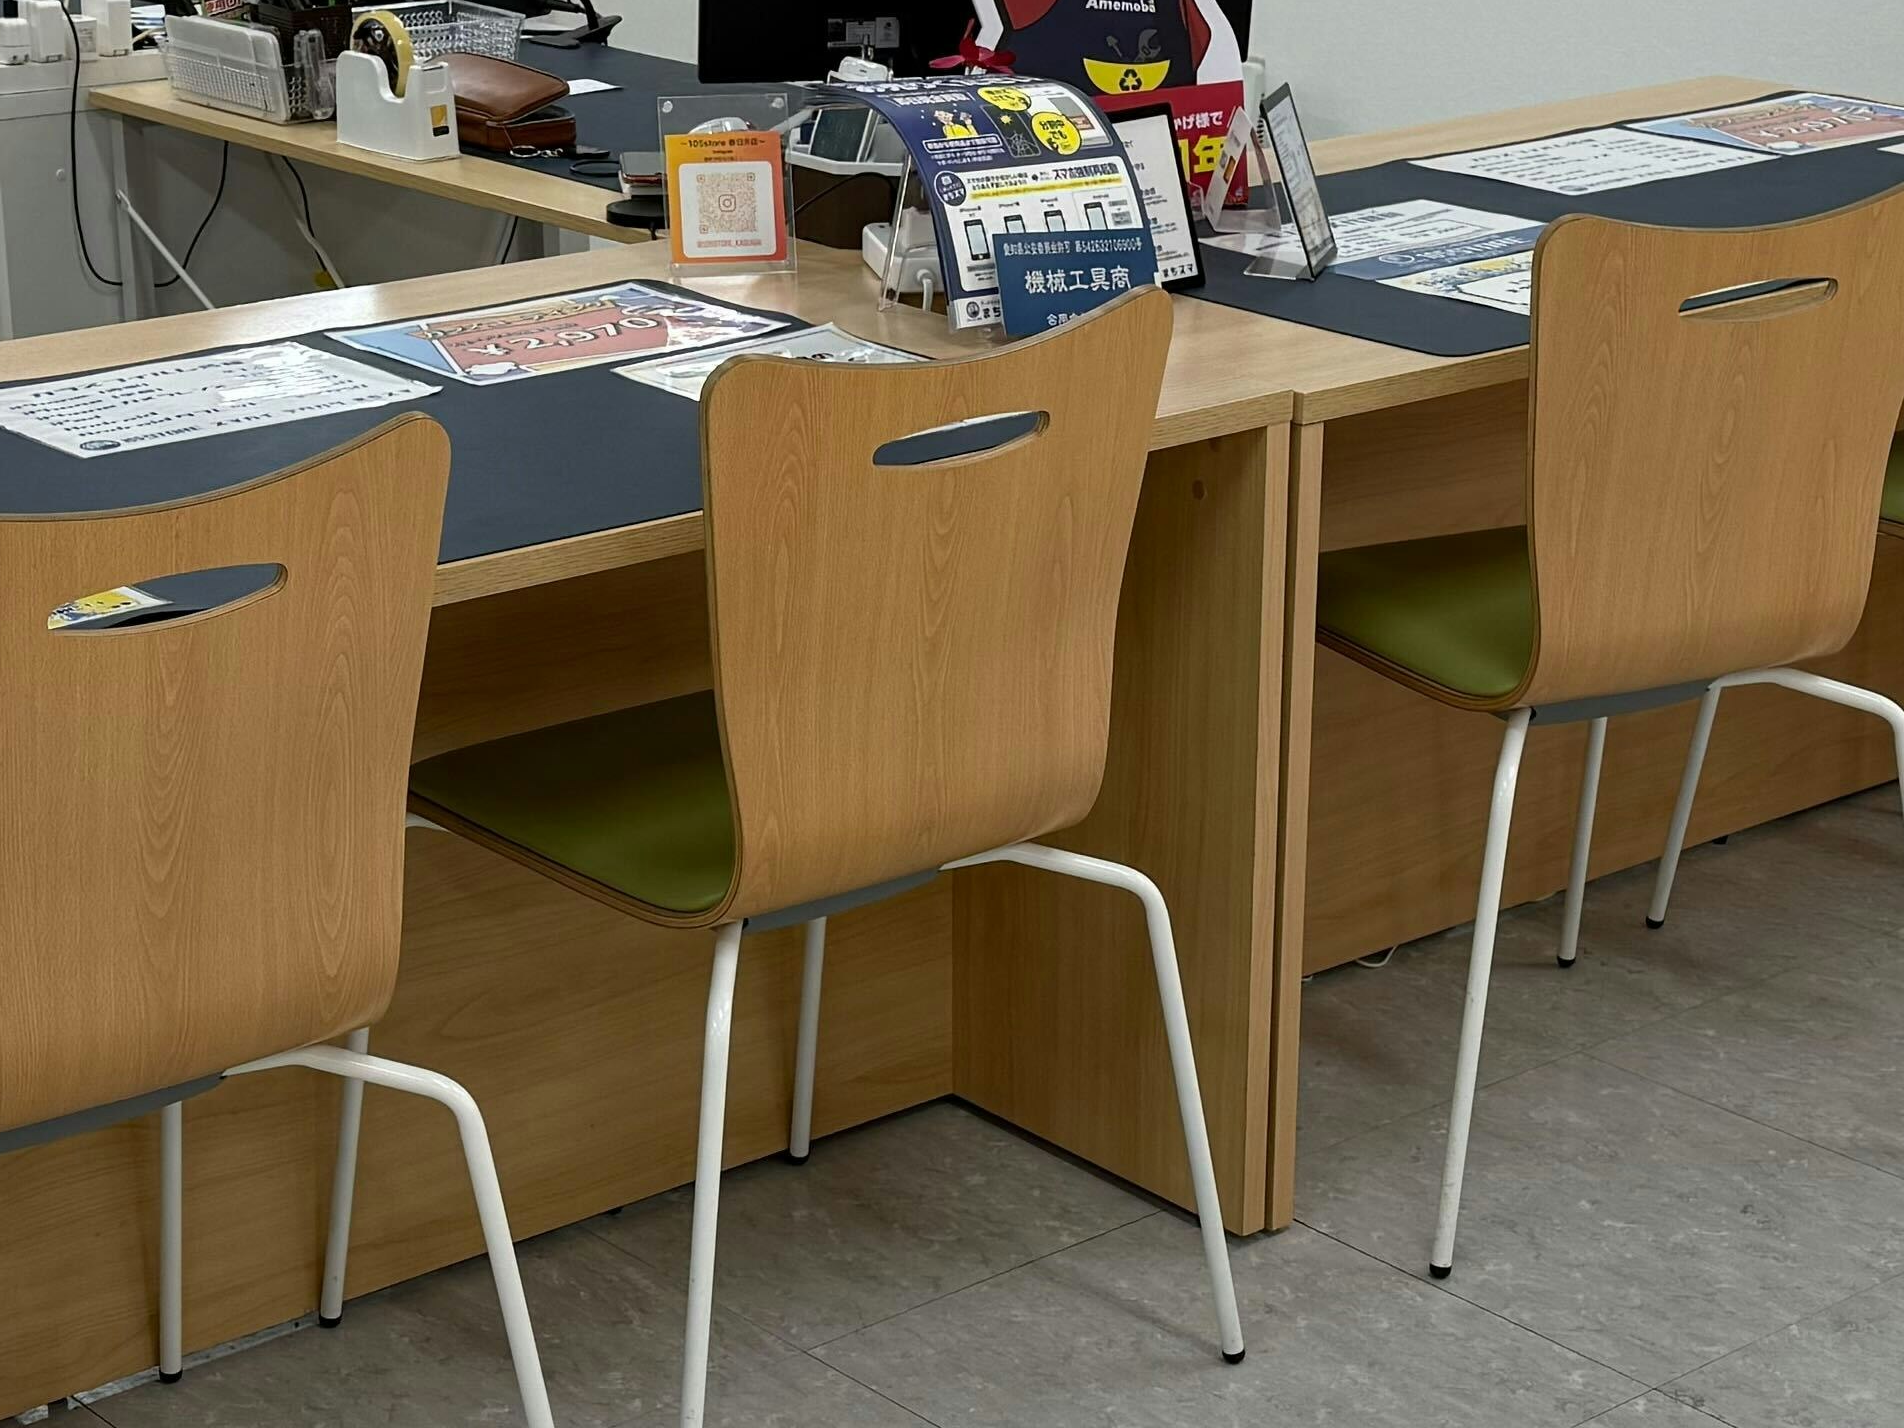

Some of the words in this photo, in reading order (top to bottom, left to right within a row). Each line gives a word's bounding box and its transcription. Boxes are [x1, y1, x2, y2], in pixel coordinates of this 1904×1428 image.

[1025, 265, 1131, 294] 機械工具商
